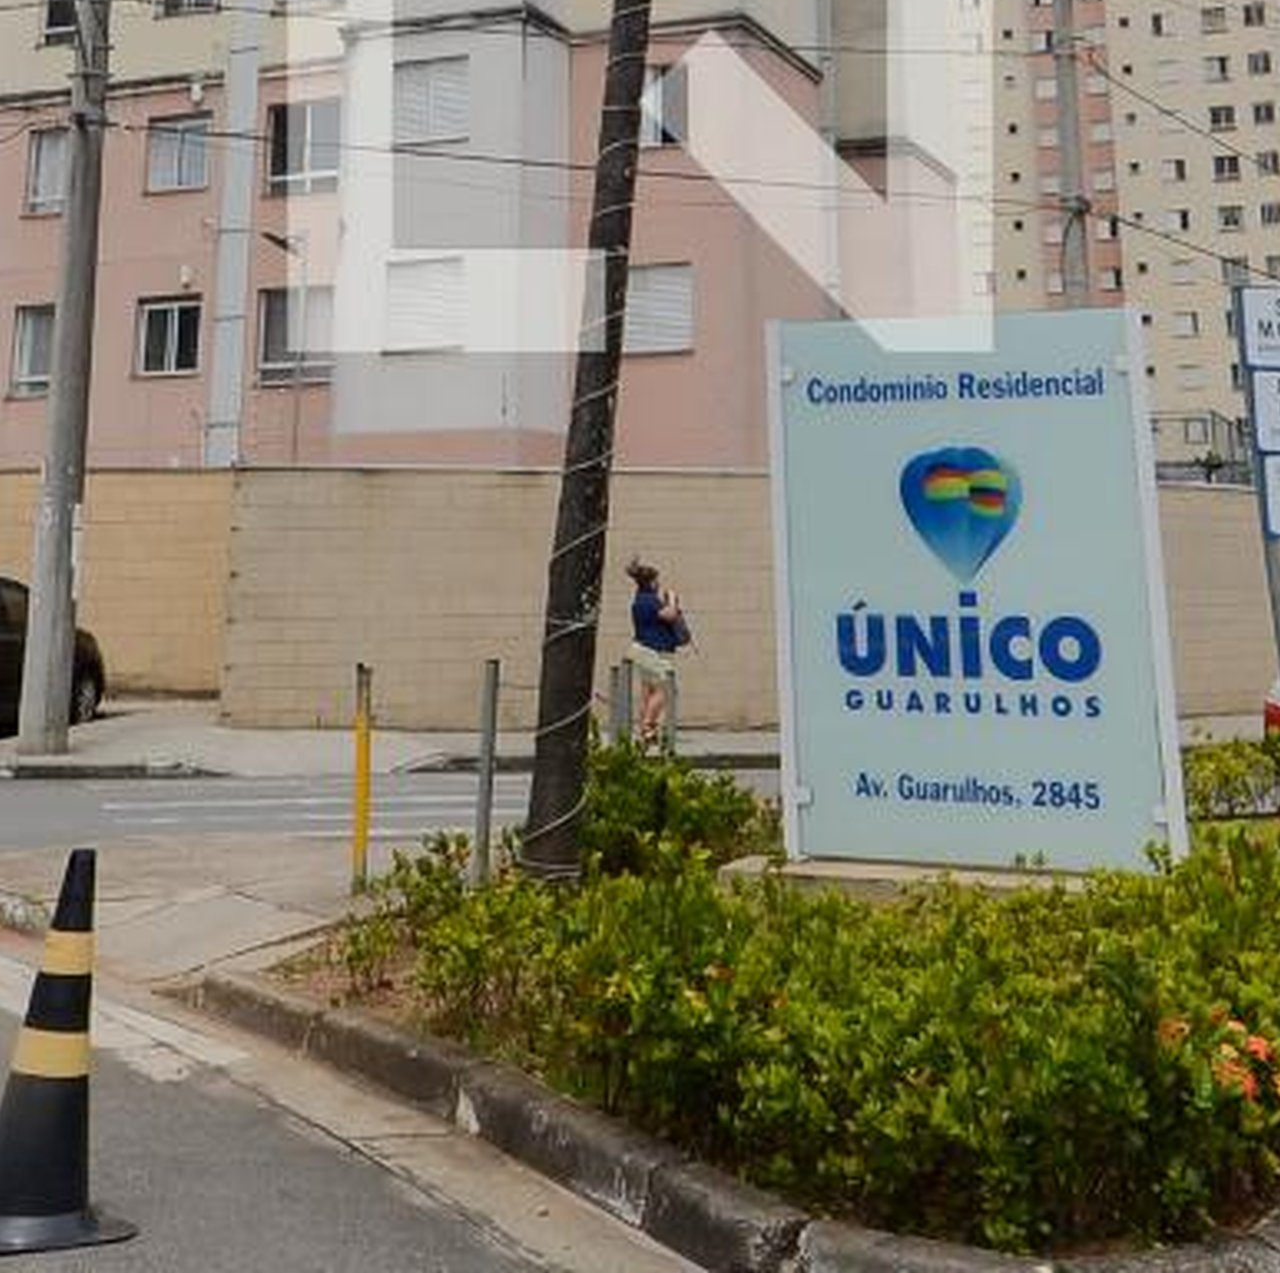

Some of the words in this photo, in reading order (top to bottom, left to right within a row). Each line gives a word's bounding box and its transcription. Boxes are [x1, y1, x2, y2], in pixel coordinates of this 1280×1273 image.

[957, 368, 1104, 399] Residencial
[845, 689, 1102, 717] GUARULHOS
[855, 772, 888, 798] Av.
[1031, 781, 1101, 810] 2845
